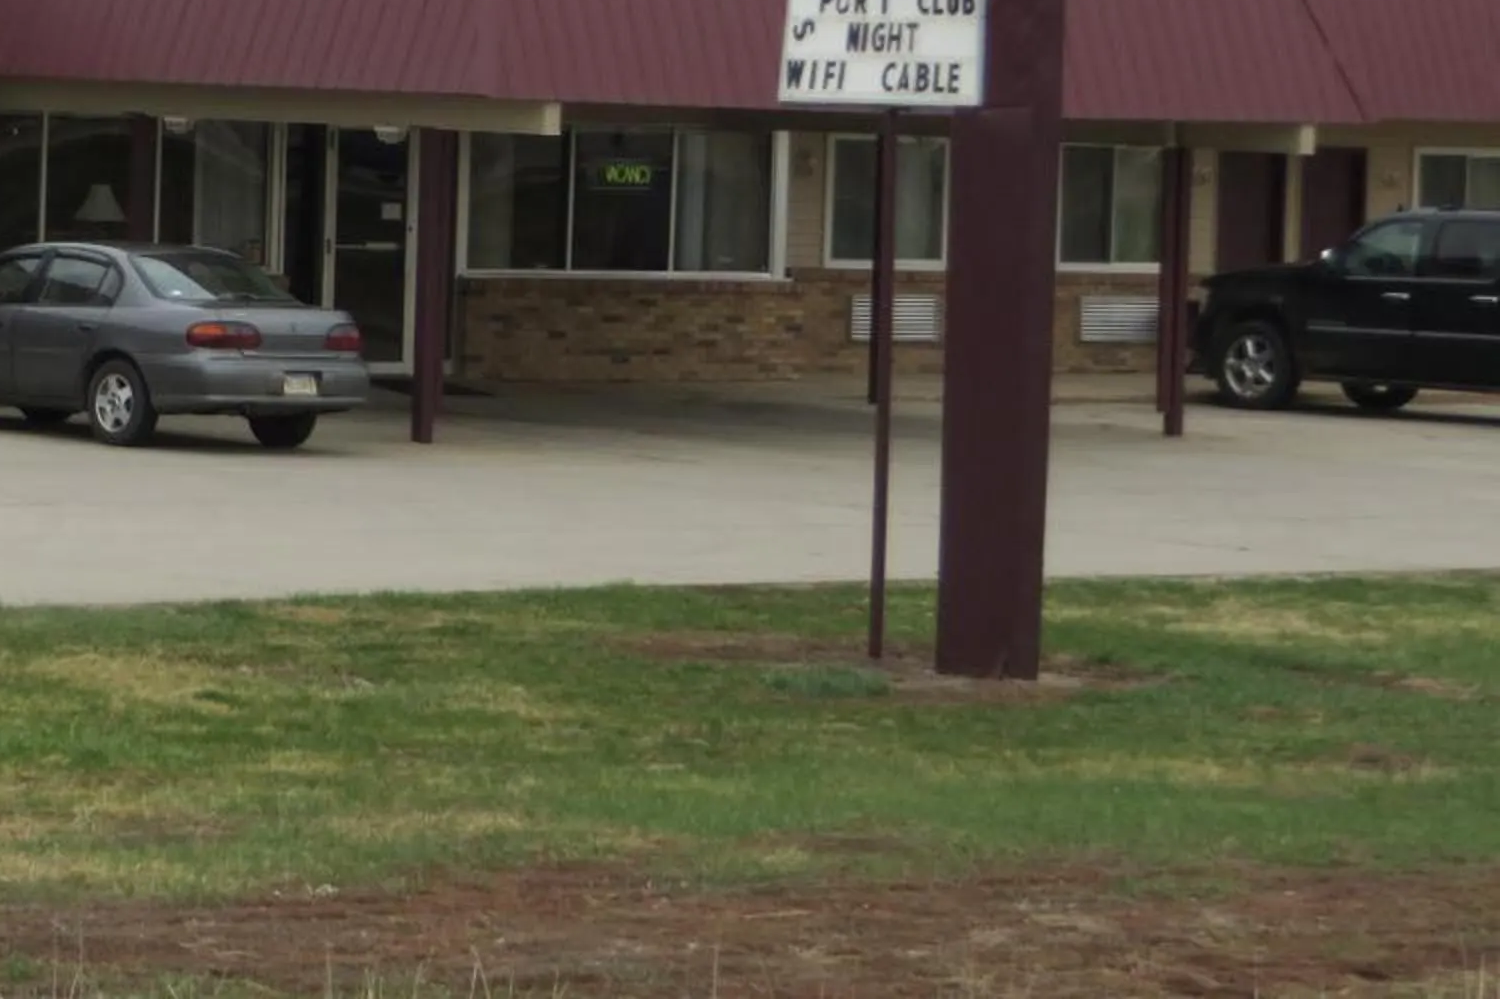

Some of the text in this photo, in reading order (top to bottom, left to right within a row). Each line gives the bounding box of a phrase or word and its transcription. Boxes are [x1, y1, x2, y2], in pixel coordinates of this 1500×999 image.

[846, 22, 920, 53] NIGHT
[786, 60, 960, 94] WIFI CABLE
